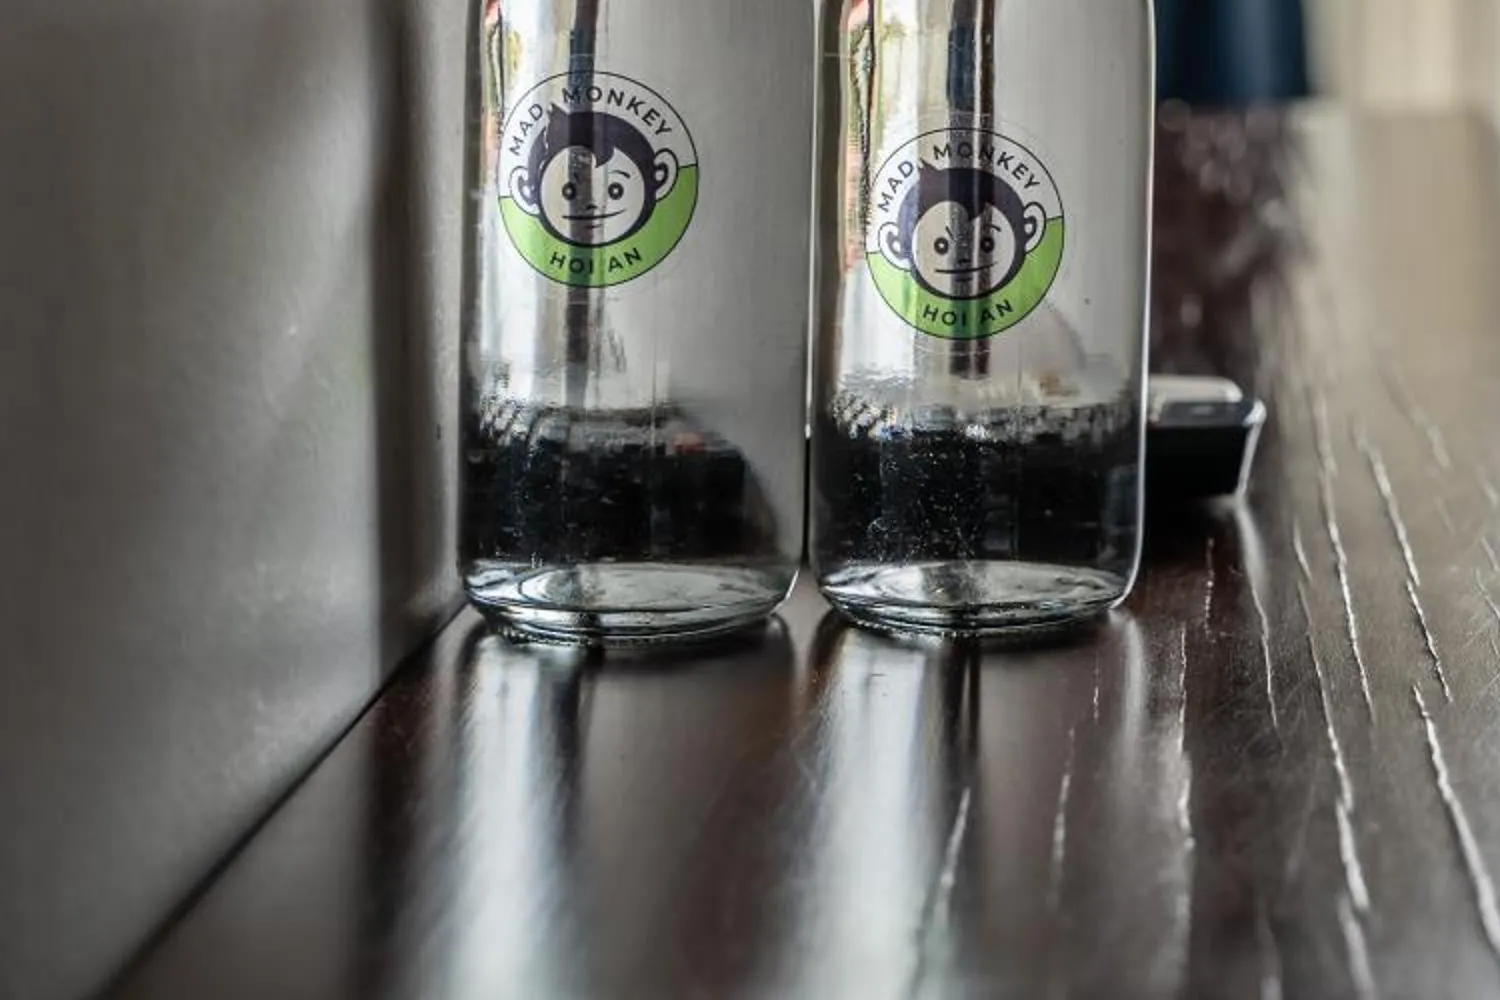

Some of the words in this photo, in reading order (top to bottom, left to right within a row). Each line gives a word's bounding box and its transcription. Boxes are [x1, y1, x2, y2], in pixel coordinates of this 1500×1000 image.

[508, 102, 543, 156] MAD
[561, 86, 672, 136] MONKEY
[877, 160, 914, 212] MAD
[932, 141, 1041, 190] MONKEY
[550, 251, 594, 274] HOI
[607, 247, 643, 273] AN
[922, 304, 968, 327] HOI
[979, 299, 1014, 324] AN
